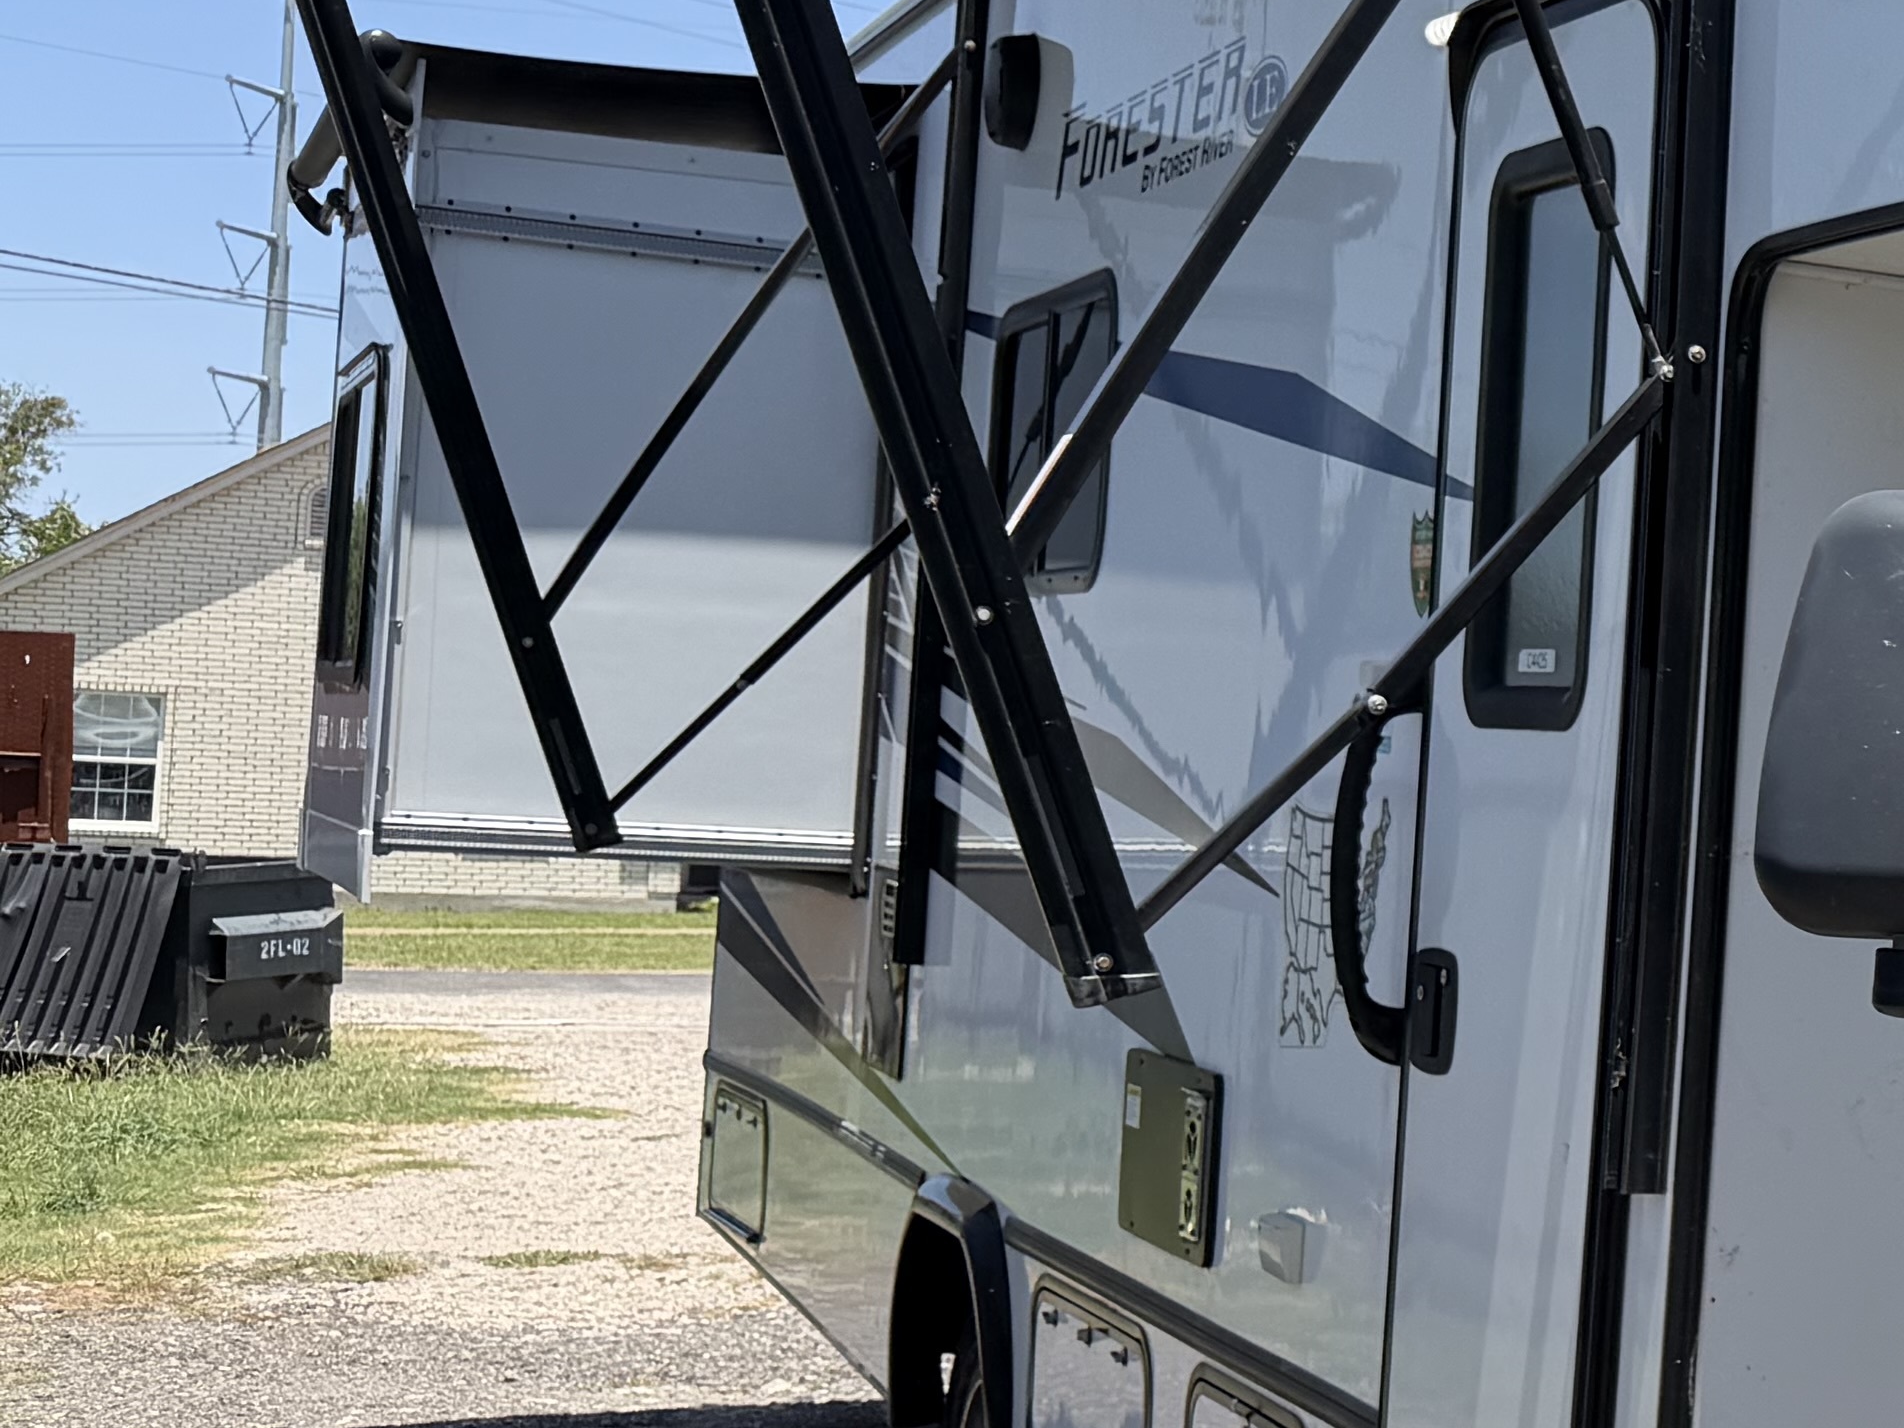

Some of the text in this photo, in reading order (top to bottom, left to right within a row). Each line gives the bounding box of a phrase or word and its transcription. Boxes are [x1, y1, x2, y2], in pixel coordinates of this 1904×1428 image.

[1055, 35, 1247, 202] FORESTER
[1141, 128, 1235, 193] BY FOREST RIVER
